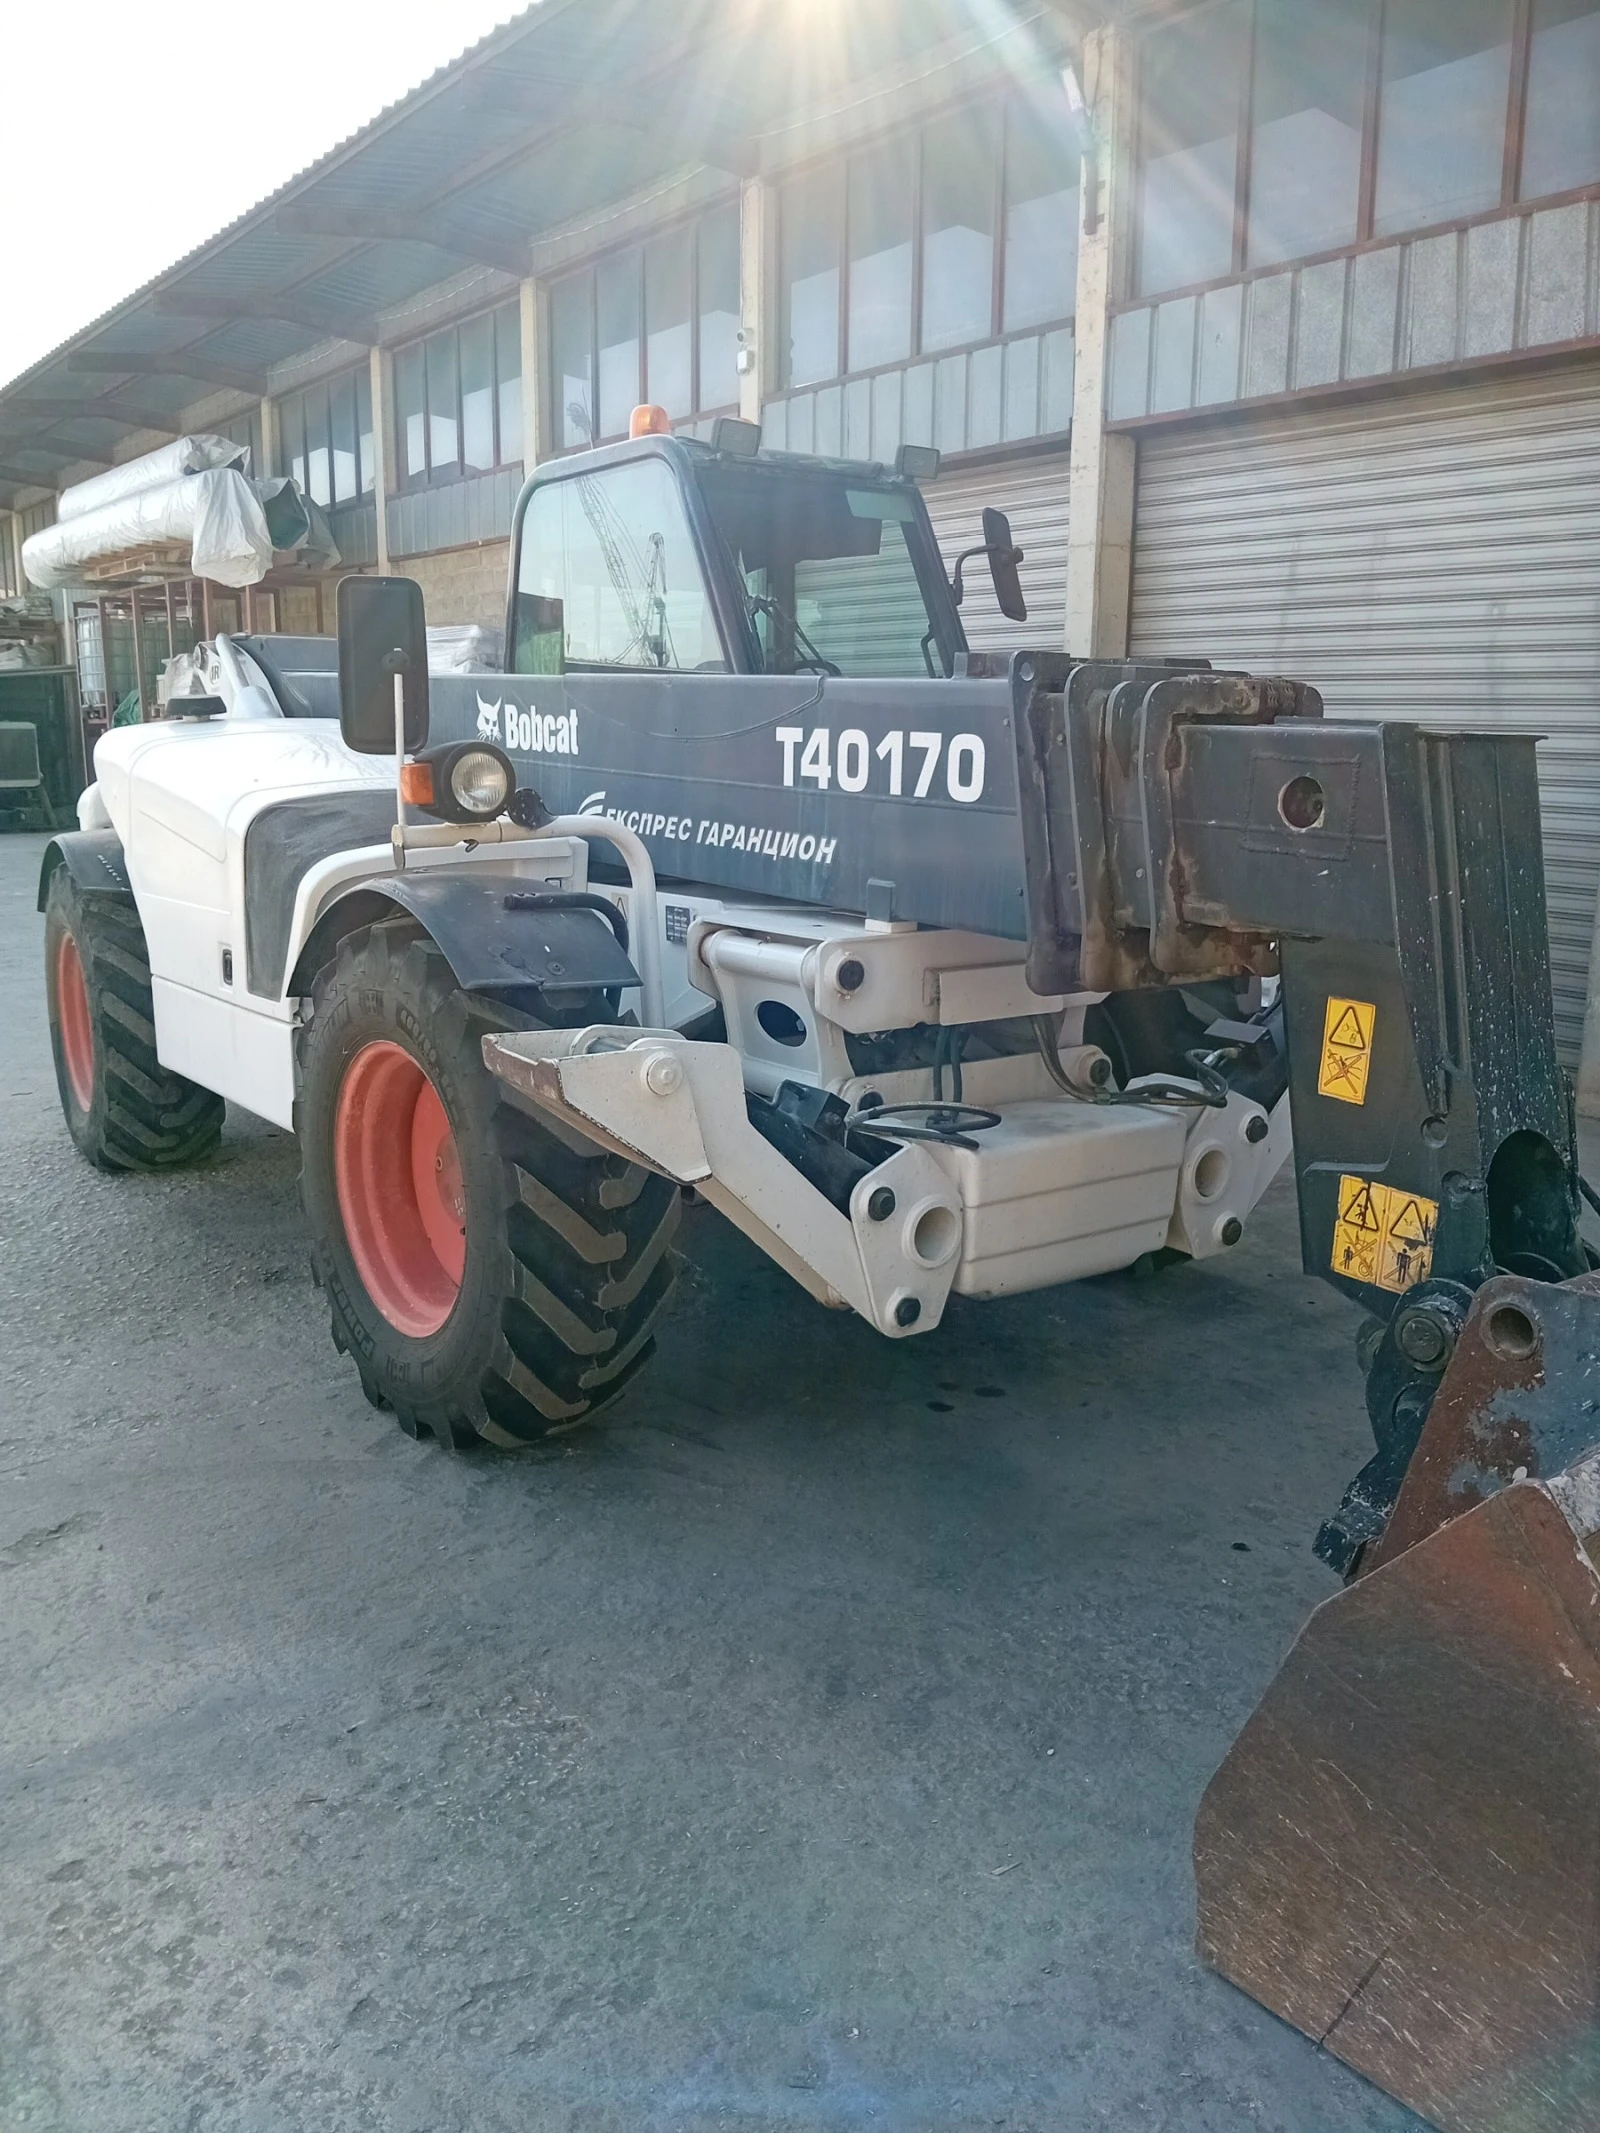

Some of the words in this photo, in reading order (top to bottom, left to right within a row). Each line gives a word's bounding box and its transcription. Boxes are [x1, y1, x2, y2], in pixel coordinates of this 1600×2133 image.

[504, 703, 579, 755] Bobcat
[775, 726, 986, 803] T40170
[696, 820, 838, 864] ГАРАНЦИОН
